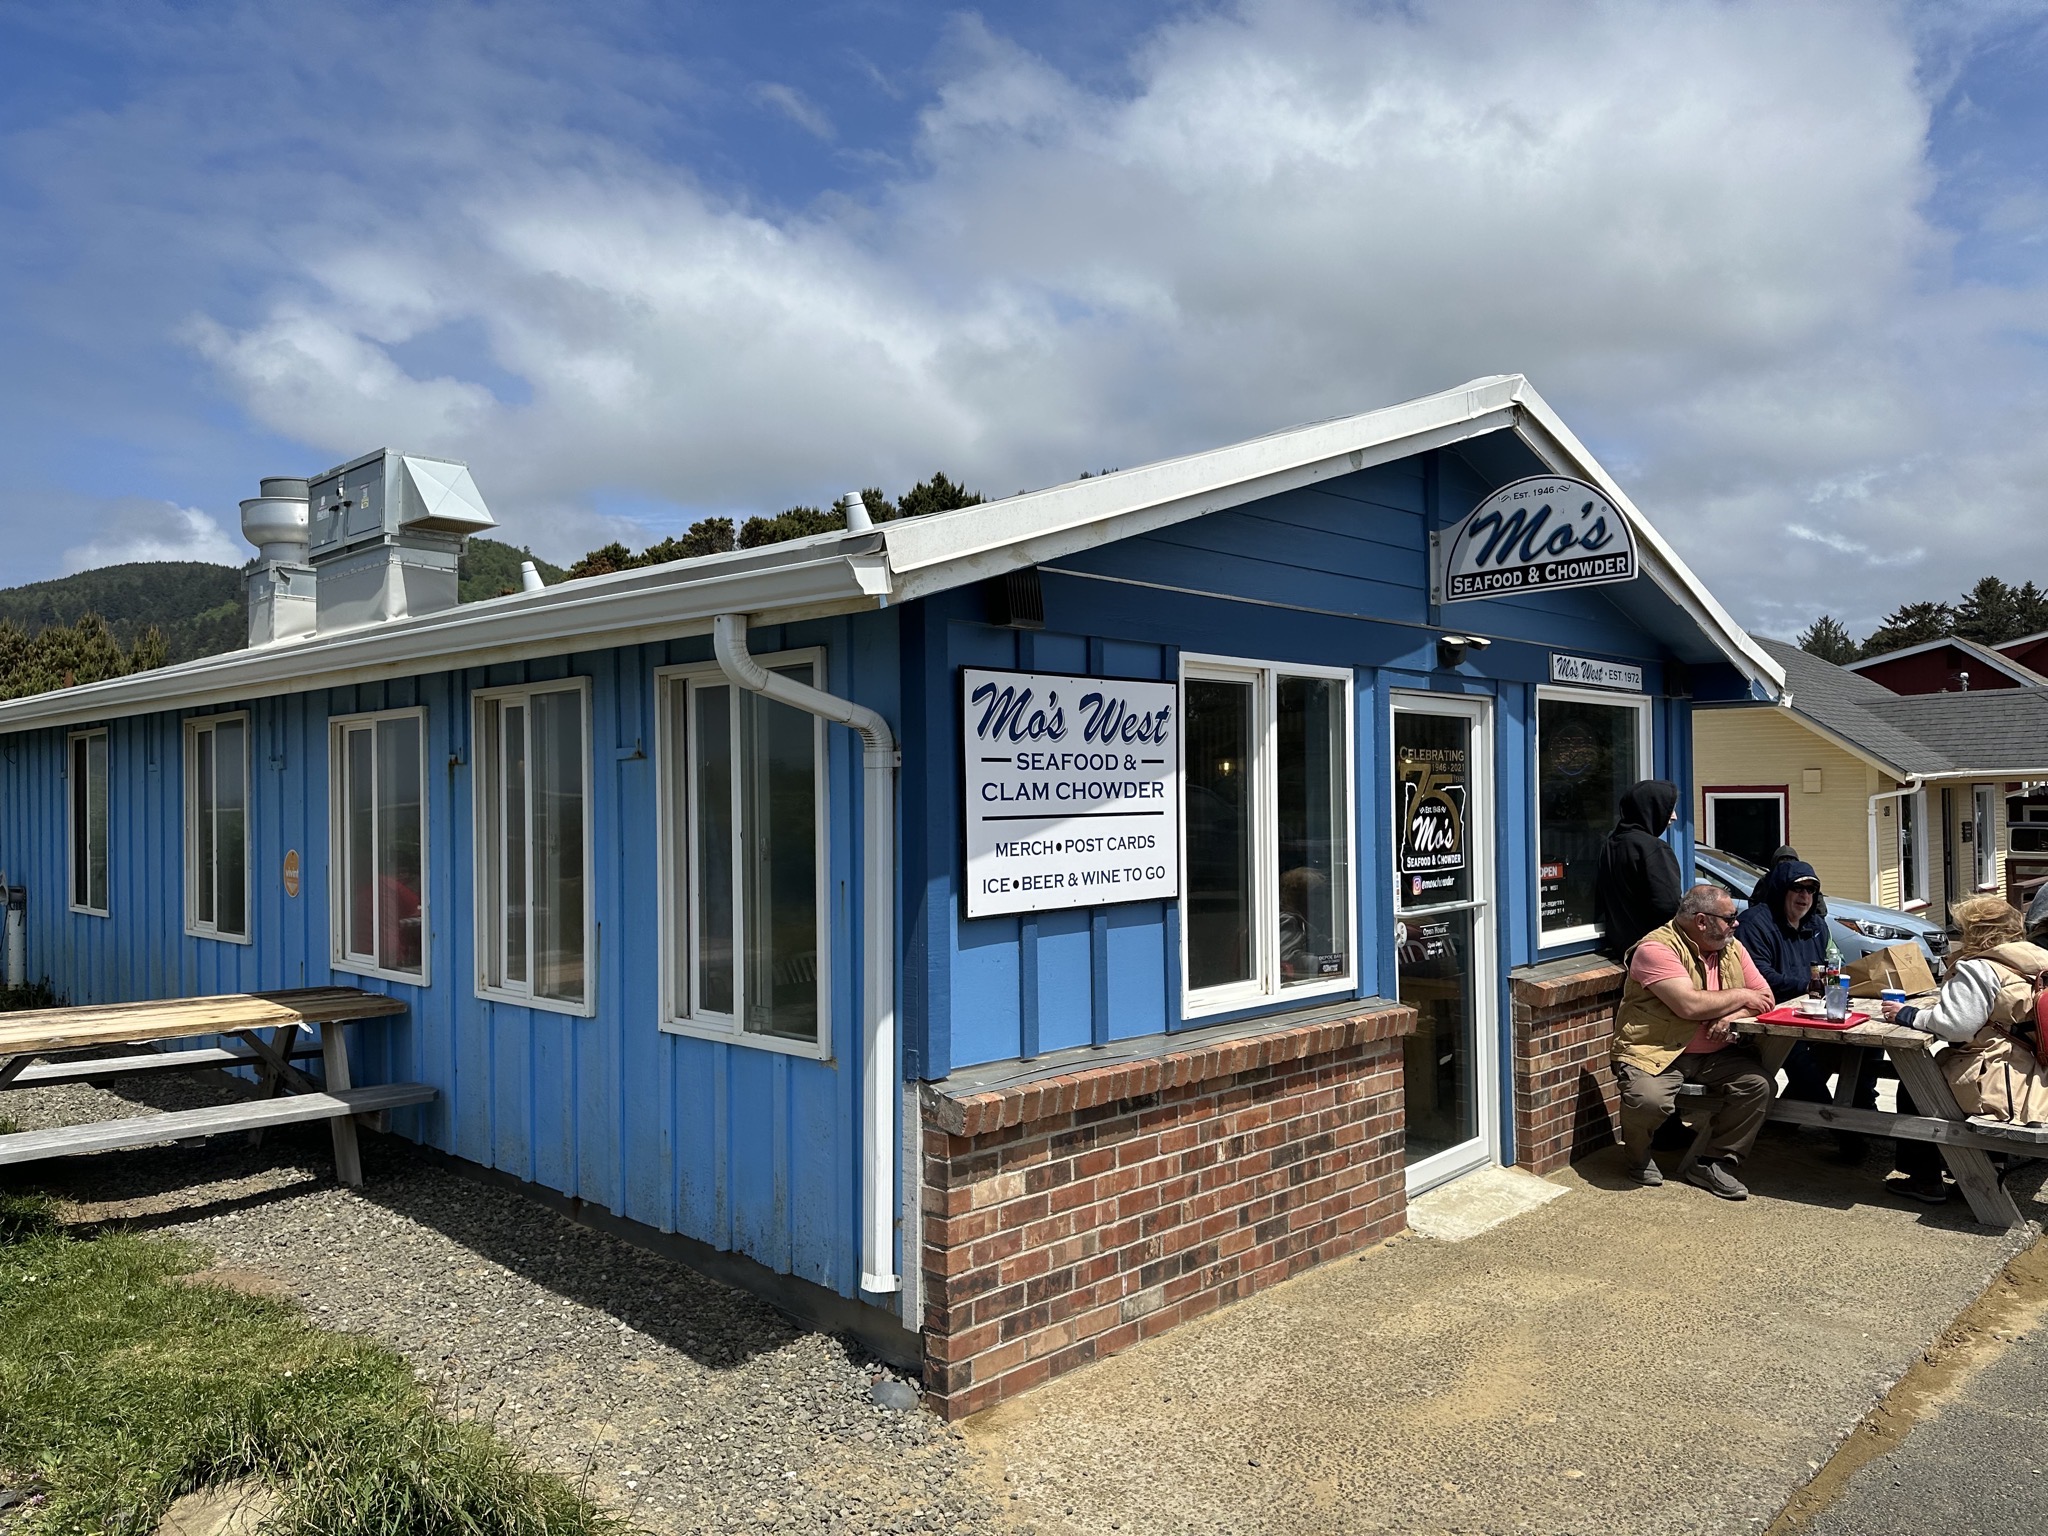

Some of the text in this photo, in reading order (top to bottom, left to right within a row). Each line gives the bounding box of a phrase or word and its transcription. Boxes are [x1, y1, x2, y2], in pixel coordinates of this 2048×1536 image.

[1533, 486, 1555, 497] 1946
[1468, 501, 1613, 567] Mo's
[1453, 556, 1627, 593] SEAFOOD & CHOWDER
[1556, 656, 1640, 684] Mo's West EST. 1972
[971, 681, 1172, 746] Mo's West
[1016, 752, 1137, 771] SEAFOOD &
[1400, 746, 1465, 762] CELEBRATING
[981, 781, 1164, 802] CLAM CHOWDER
[1412, 815, 1454, 852] Mo's
[995, 834, 1156, 858] MERCH POST CARDS
[1406, 856, 1431, 868] SEAFOOD
[1431, 854, 1437, 866] &
[1540, 866, 1558, 878] OPEN
[982, 865, 1166, 894] ICE BEER & WINE TO GO
